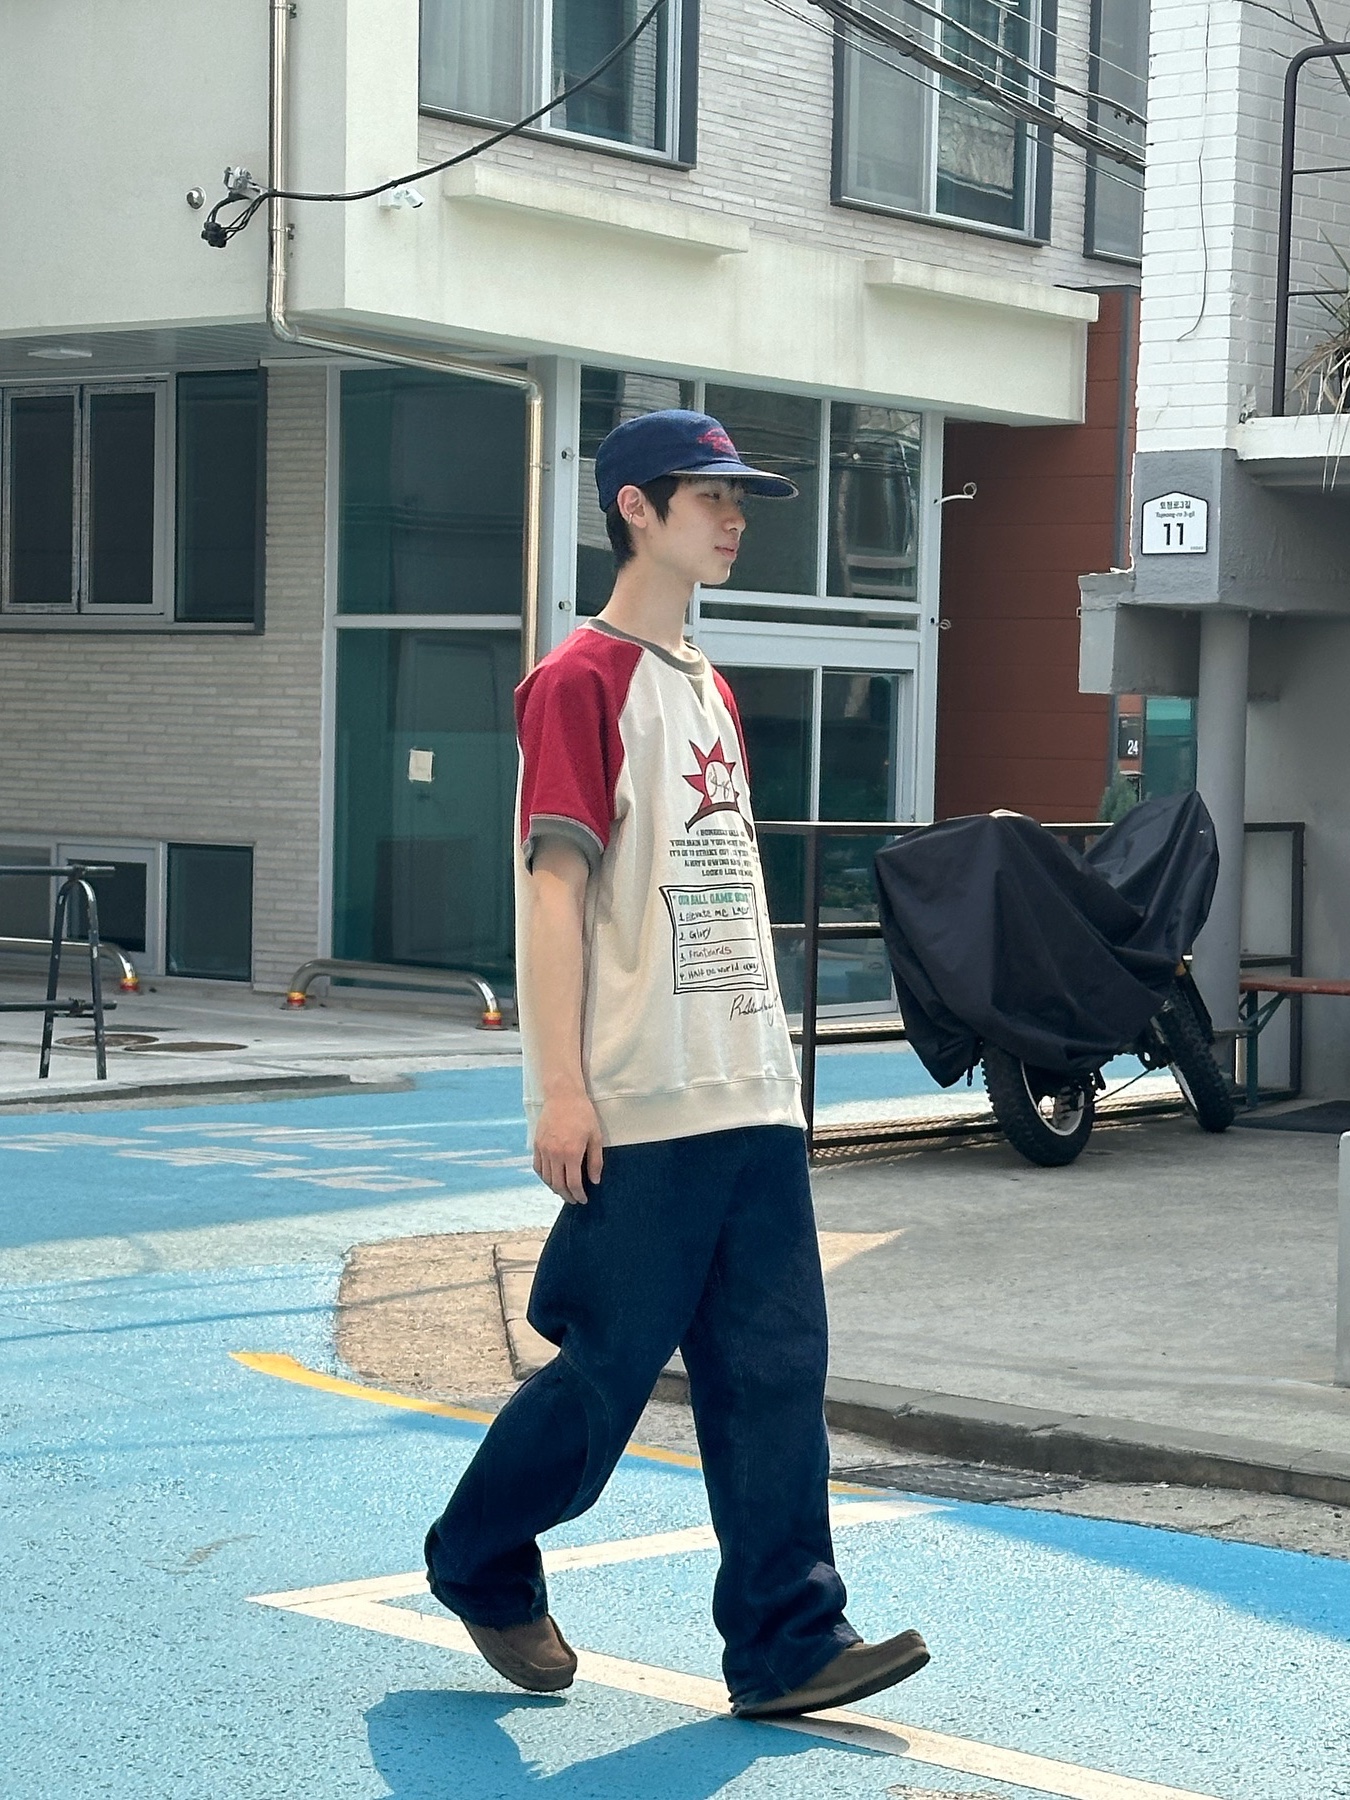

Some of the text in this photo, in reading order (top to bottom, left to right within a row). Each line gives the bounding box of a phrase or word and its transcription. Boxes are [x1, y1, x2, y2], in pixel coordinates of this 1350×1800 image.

[1163, 523, 1184, 546] 11
[1127, 739, 1139, 755] 24
[691, 893, 708, 905] BALL
[710, 892, 733, 904] GAME
[689, 926, 711, 941] Glory
